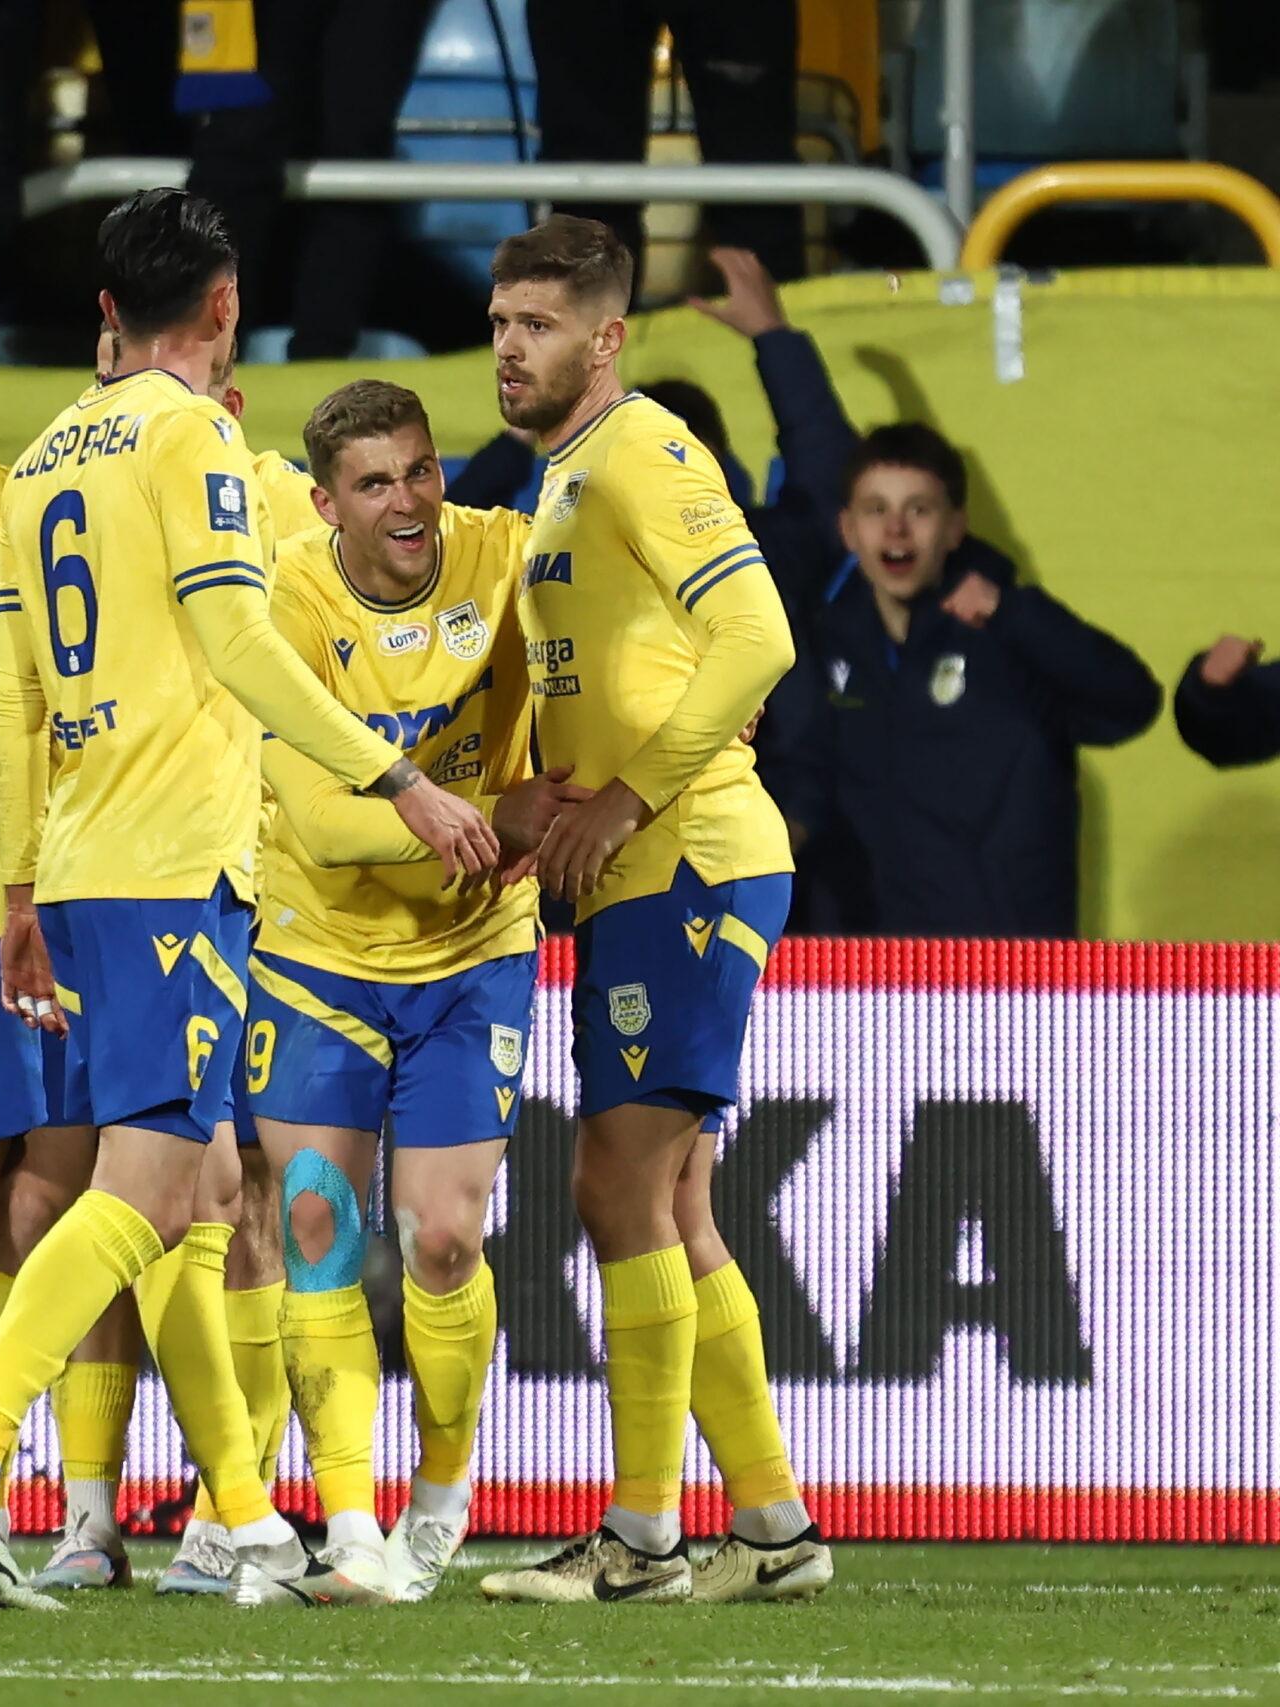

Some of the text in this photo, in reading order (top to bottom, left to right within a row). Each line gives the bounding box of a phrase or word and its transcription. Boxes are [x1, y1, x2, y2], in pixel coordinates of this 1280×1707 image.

[40, 489, 98, 678] 6
[388, 630, 419, 649] LOTTO
[454, 630, 480, 645] ARKA
[186, 1015, 220, 1092] 6
